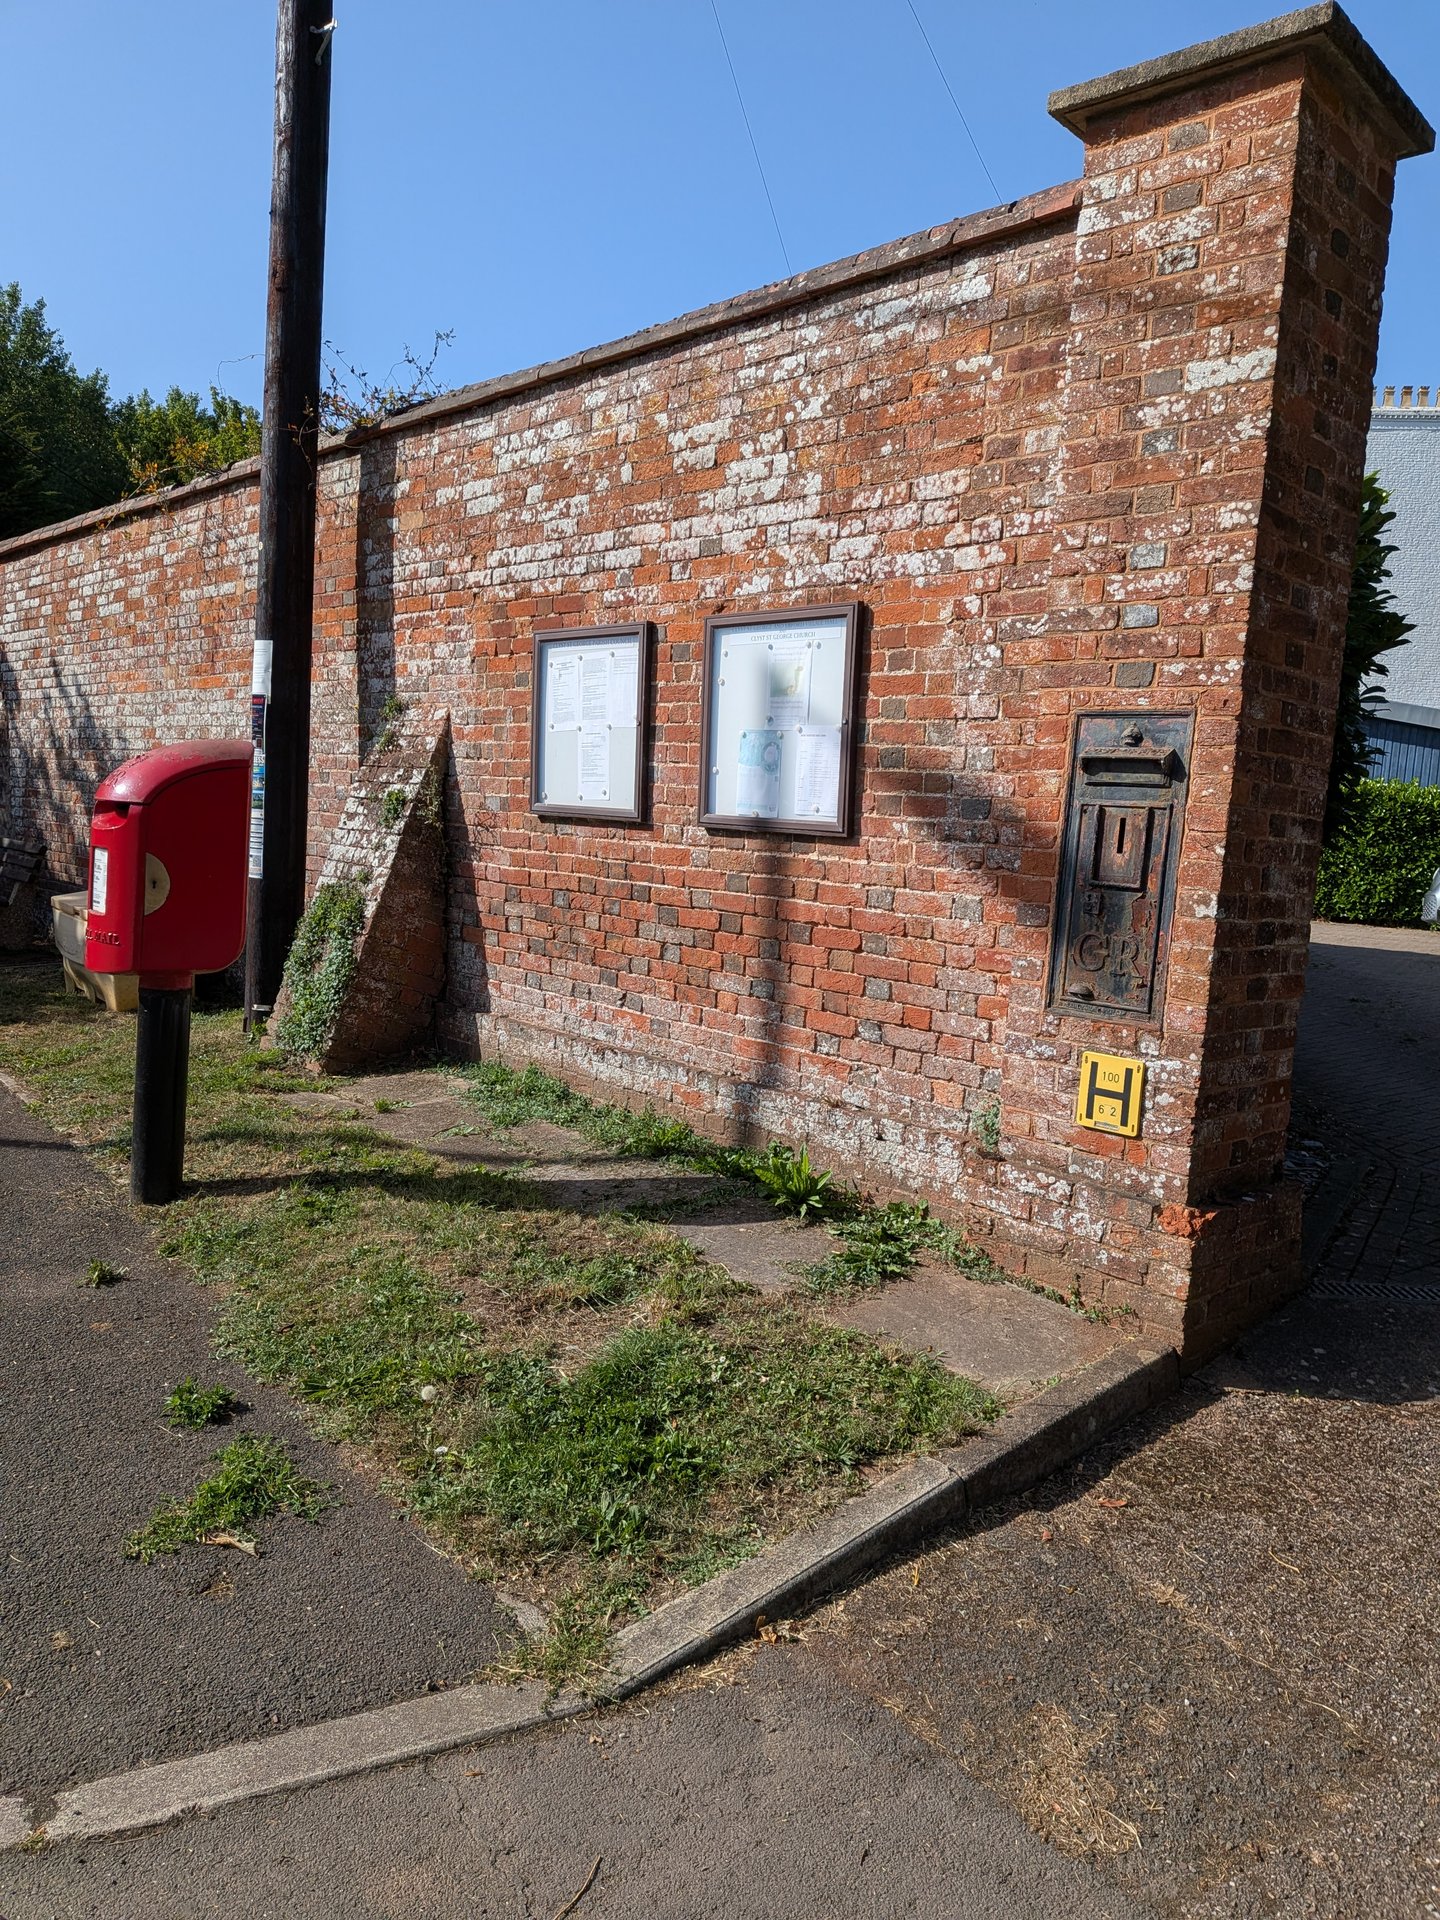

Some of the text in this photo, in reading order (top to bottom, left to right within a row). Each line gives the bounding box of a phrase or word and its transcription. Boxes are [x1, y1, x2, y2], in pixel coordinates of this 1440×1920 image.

[94, 930, 120, 946] MAIL
[1102, 1071, 1120, 1084] 100
[1085, 1061, 1134, 1128] H
